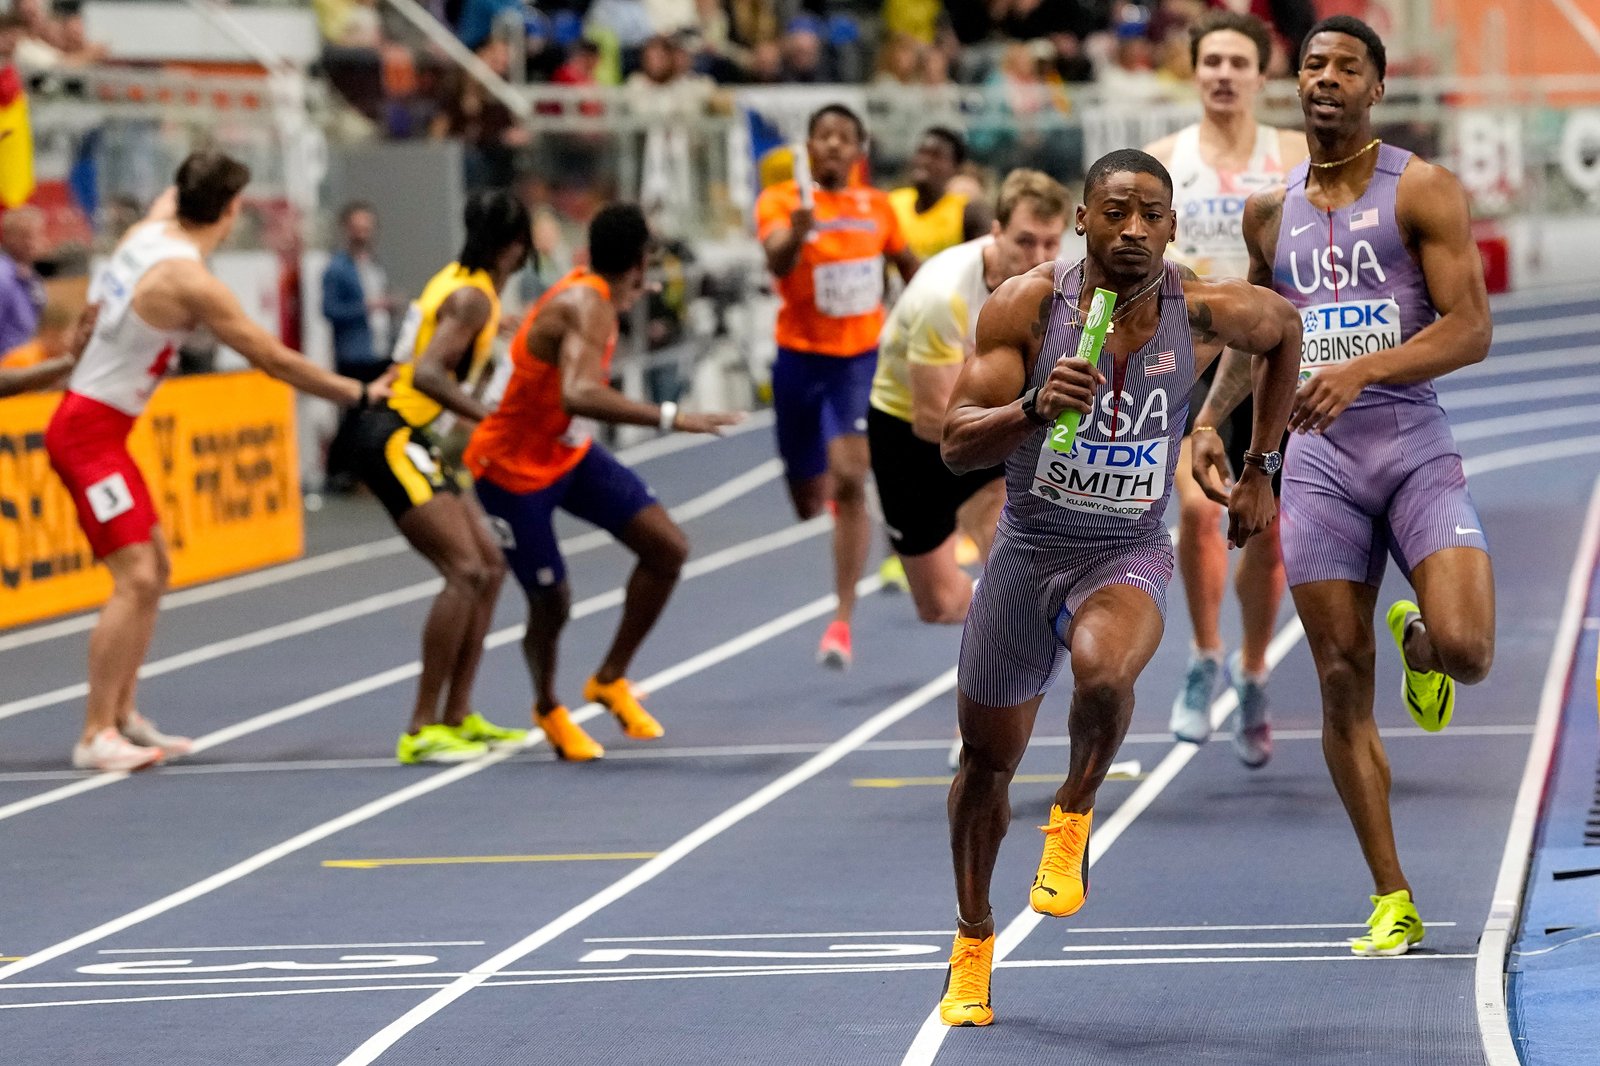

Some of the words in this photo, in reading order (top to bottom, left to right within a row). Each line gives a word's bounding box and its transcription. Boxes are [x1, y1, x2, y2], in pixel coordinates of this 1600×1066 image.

[1202, 197, 1245, 215] TD
[1183, 219, 1243, 241] IGUAC
[1290, 240, 1386, 294] USA
[1318, 303, 1390, 330] TDK
[1301, 332, 1395, 363] ROBINSON
[1053, 424, 1069, 443] 2
[1080, 441, 1159, 468] TDK
[1047, 461, 1154, 497] SMITH
[1066, 498, 1101, 510] KUJAWY
[1102, 505, 1144, 515] POMORZE
